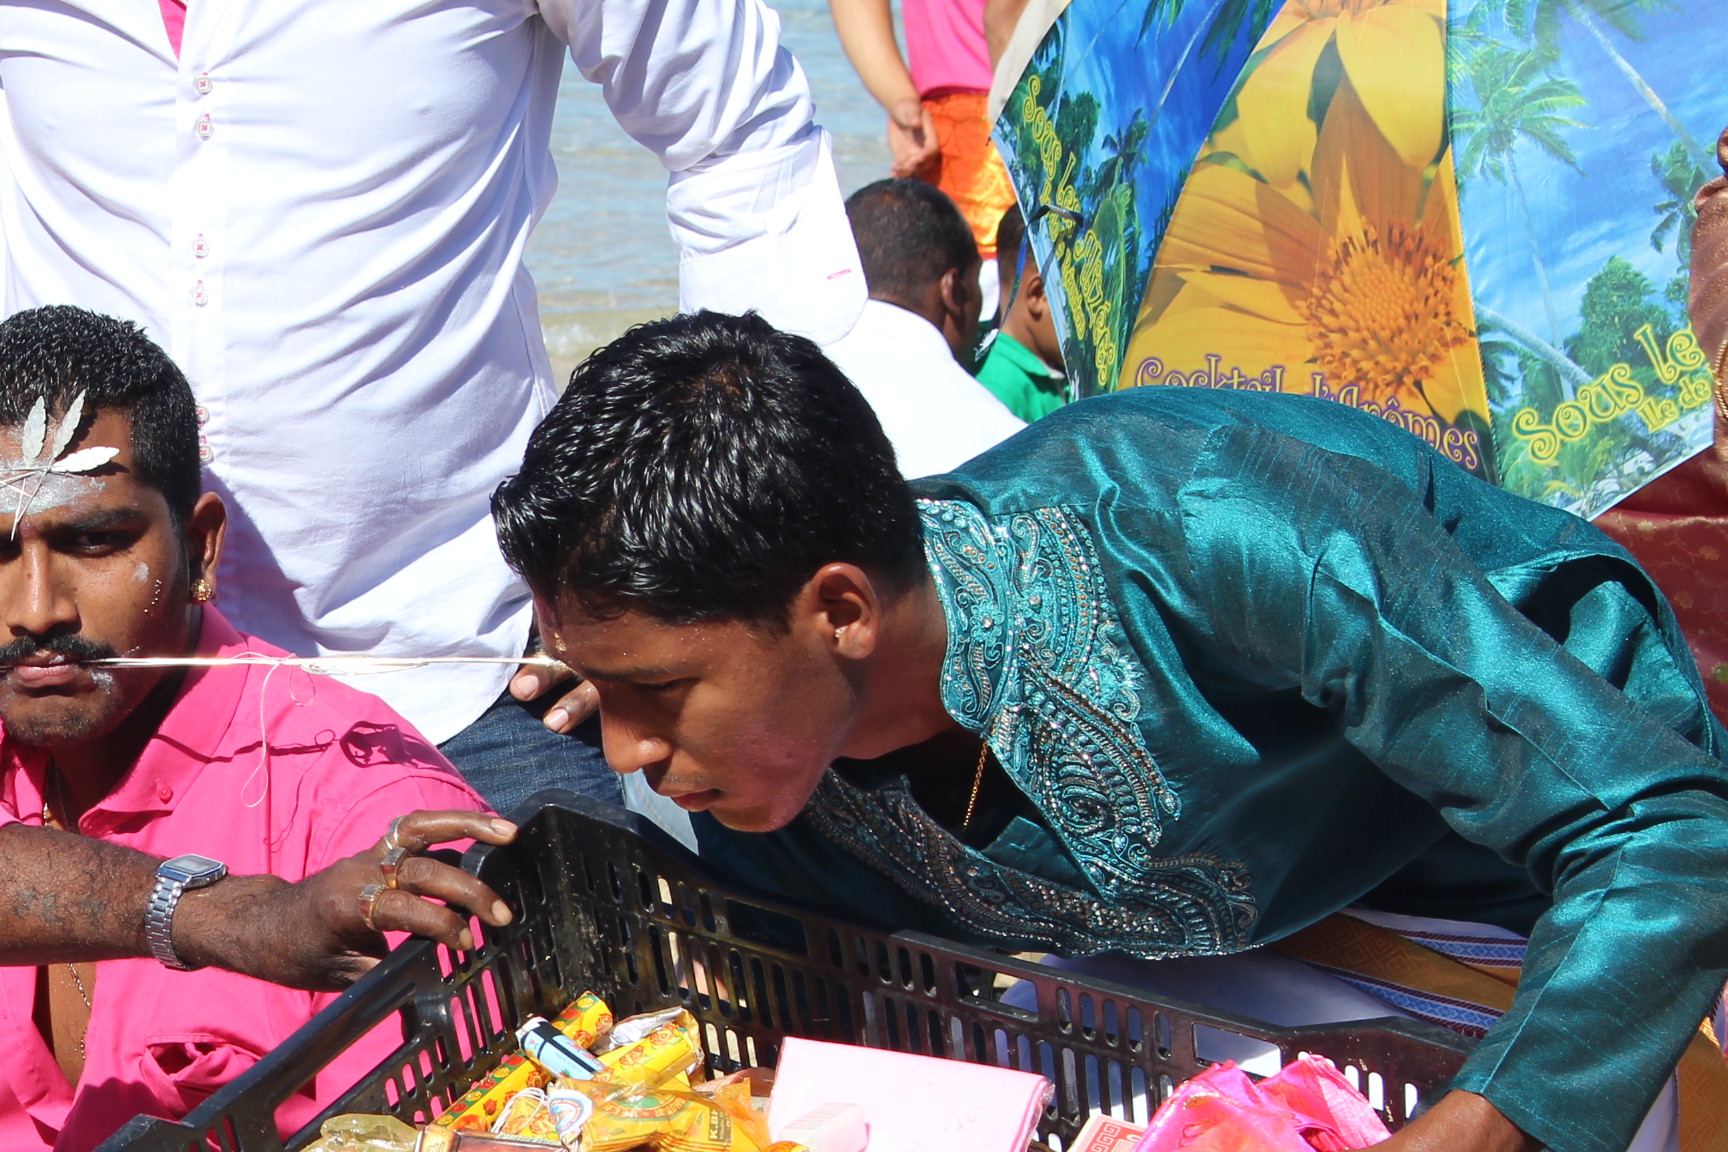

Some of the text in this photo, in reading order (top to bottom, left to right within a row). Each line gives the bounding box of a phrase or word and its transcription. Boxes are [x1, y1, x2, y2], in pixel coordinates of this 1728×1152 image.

[1023, 75, 1062, 181] Sous
[1312, 373, 1479, 470] 'Arômes
[1512, 322, 1708, 464] Sous le
[1678, 375, 1714, 409] de
